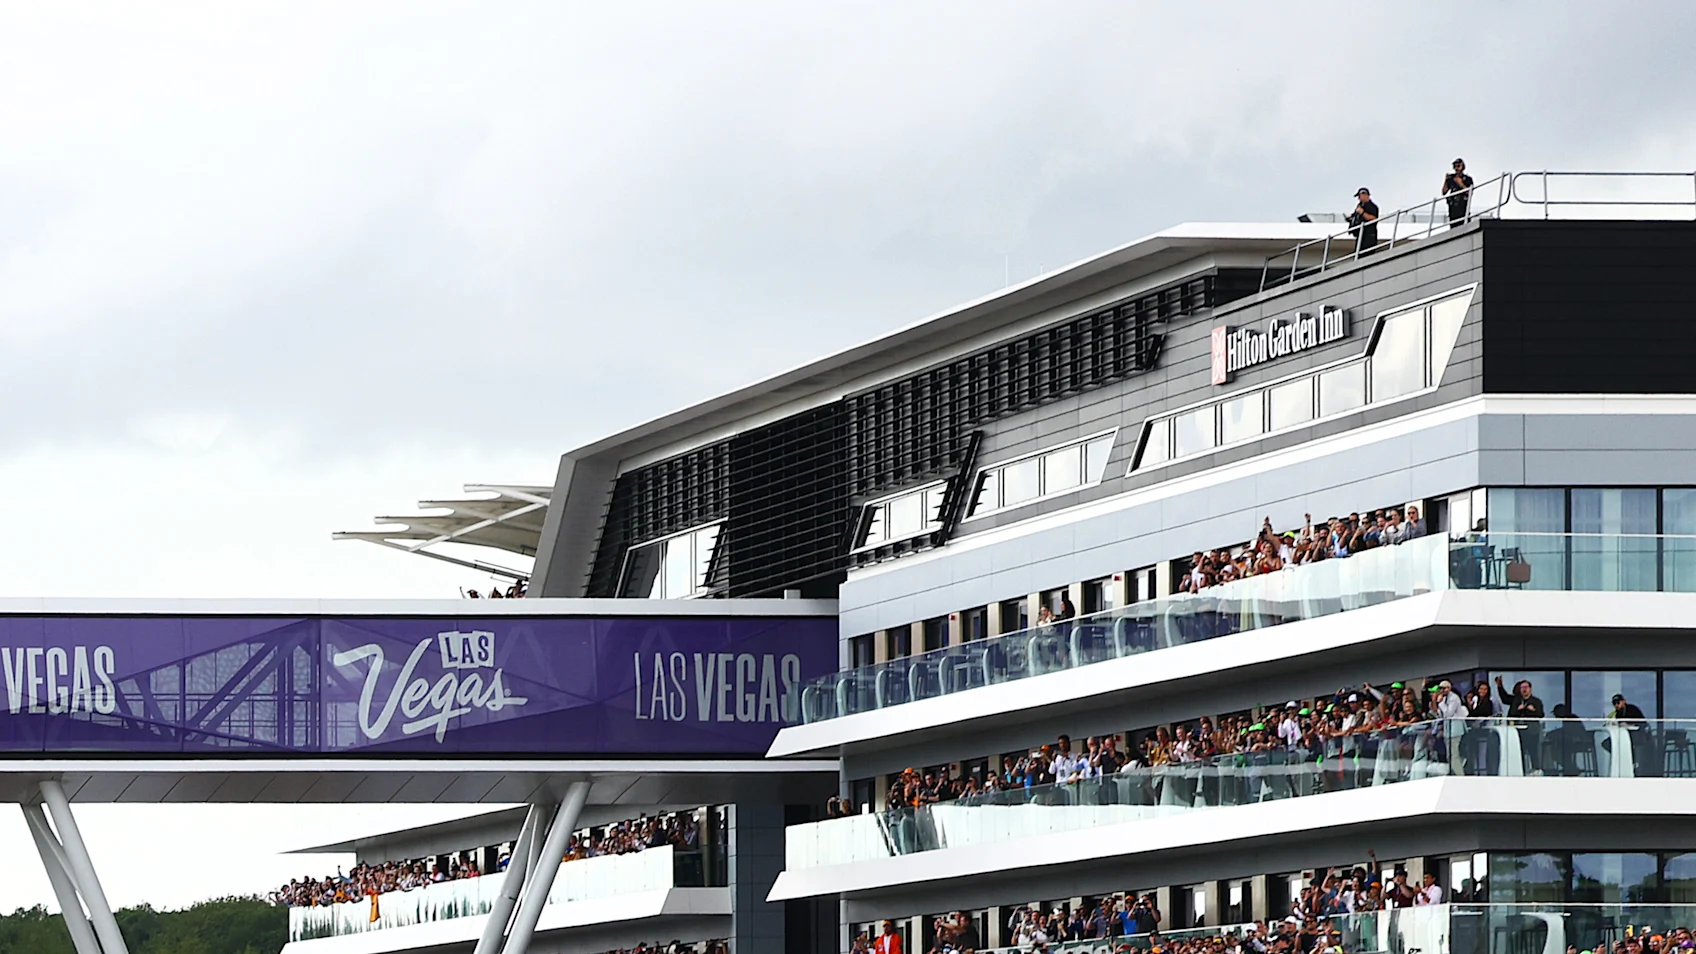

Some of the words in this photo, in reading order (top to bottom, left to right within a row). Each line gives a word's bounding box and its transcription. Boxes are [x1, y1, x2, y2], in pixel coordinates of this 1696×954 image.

[1227, 328, 1267, 372] Hilton
[1268, 312, 1317, 358] Garden
[1319, 304, 1344, 344] Inn
[1, 646, 115, 716] VEGAS
[445, 635, 489, 664] LAS
[634, 652, 686, 721] LAS
[694, 653, 801, 722] VEGAS
